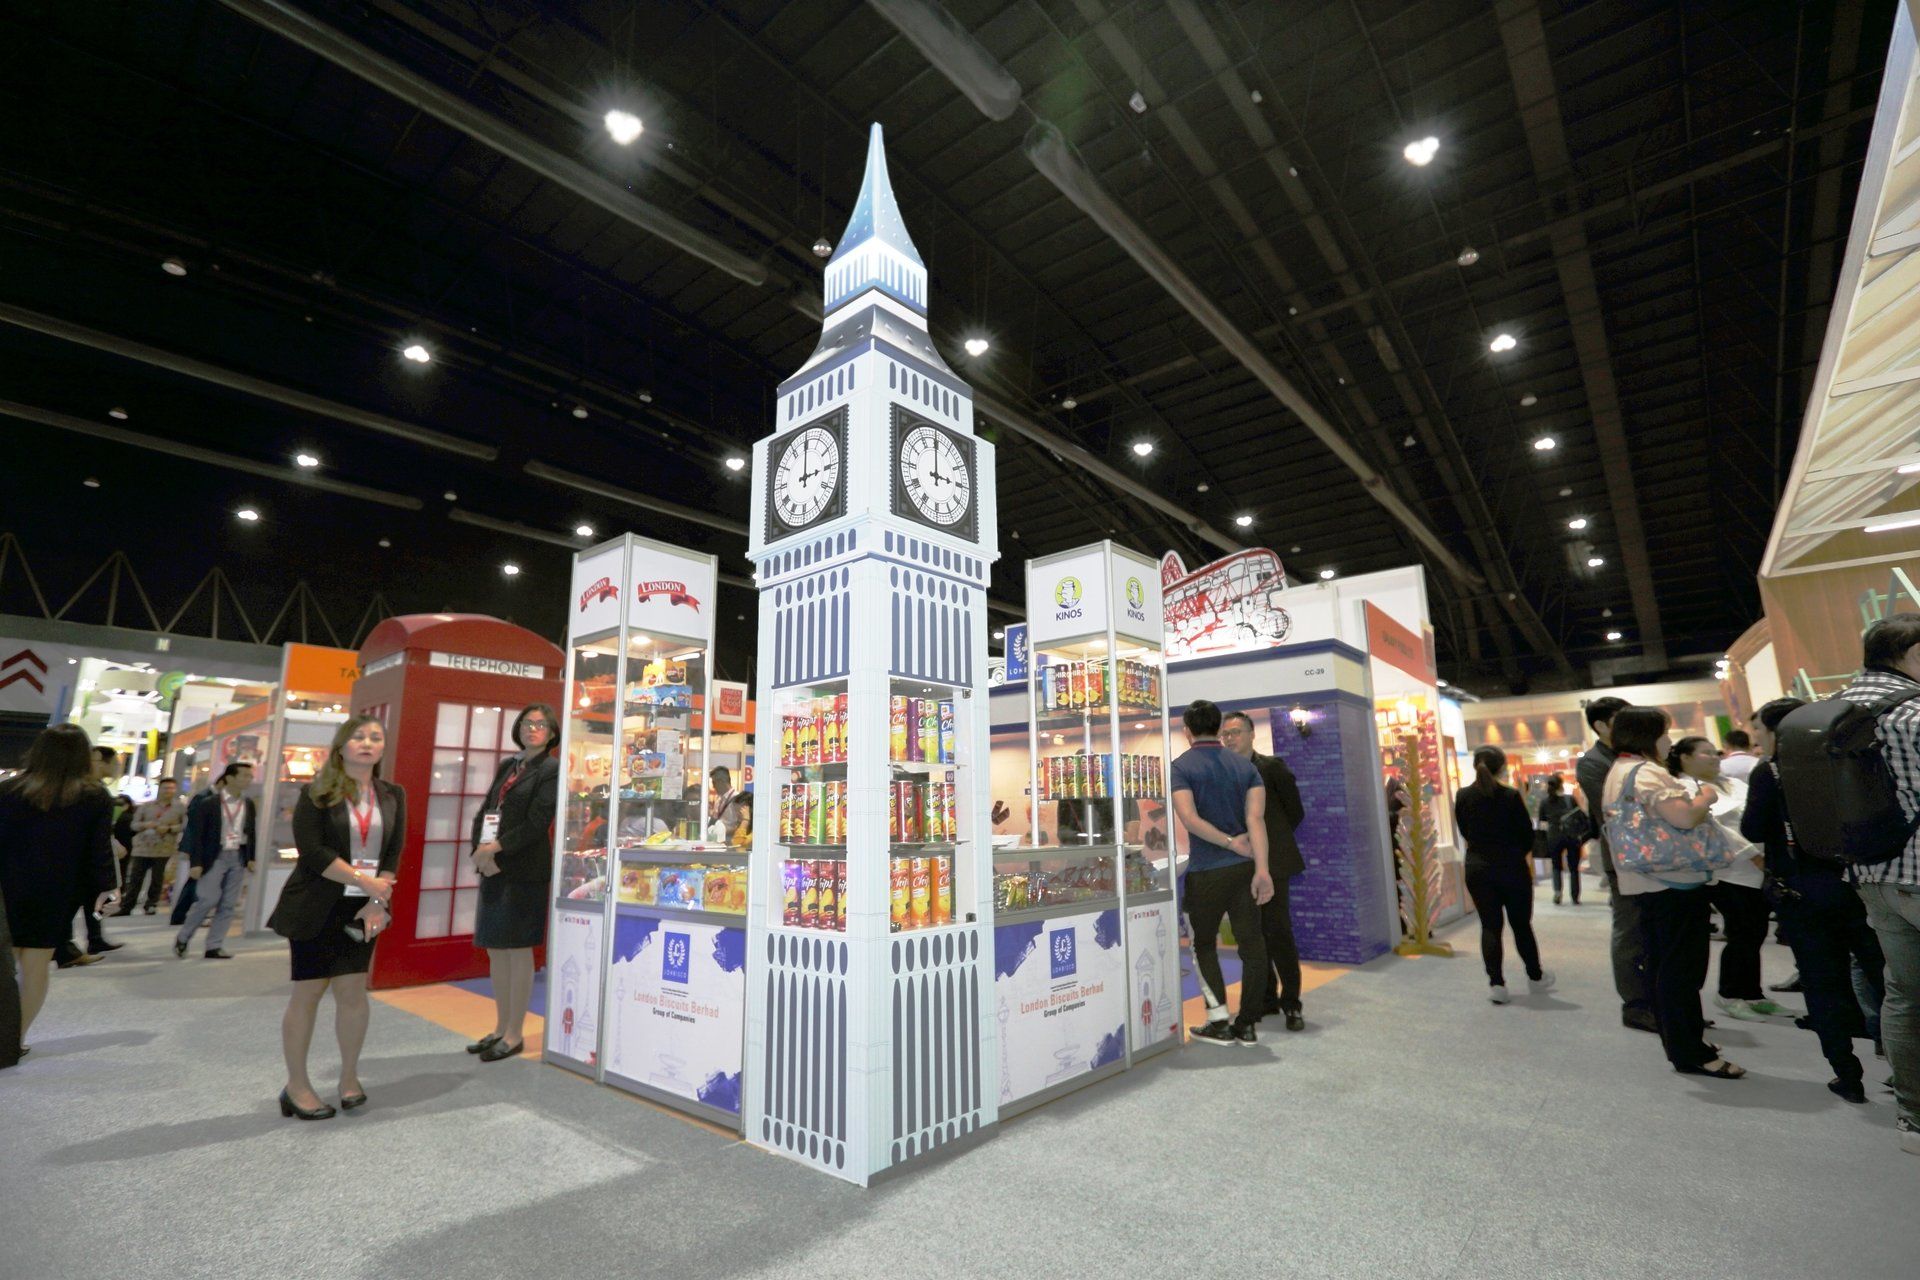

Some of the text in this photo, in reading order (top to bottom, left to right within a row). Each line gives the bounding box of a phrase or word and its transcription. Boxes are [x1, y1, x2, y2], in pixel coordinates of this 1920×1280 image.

[581, 579, 609, 601] LONDON
[641, 581, 682, 593] LONDON
[1055, 608, 1083, 621] KINOS
[1127, 608, 1145, 622] KINOS
[446, 655, 530, 677] TELEPHONE
[634, 989, 657, 1004] London
[659, 995, 689, 1012] Biscuits
[691, 1001, 719, 1018] Berhad
[1021, 998, 1049, 1014] London
[1050, 990, 1079, 1006] Biscuits
[1081, 981, 1104, 997] Berhad
[652, 1007, 665, 1017] Group
[671, 1012, 695, 1023] Companies
[1044, 1008, 1057, 1018] Group
